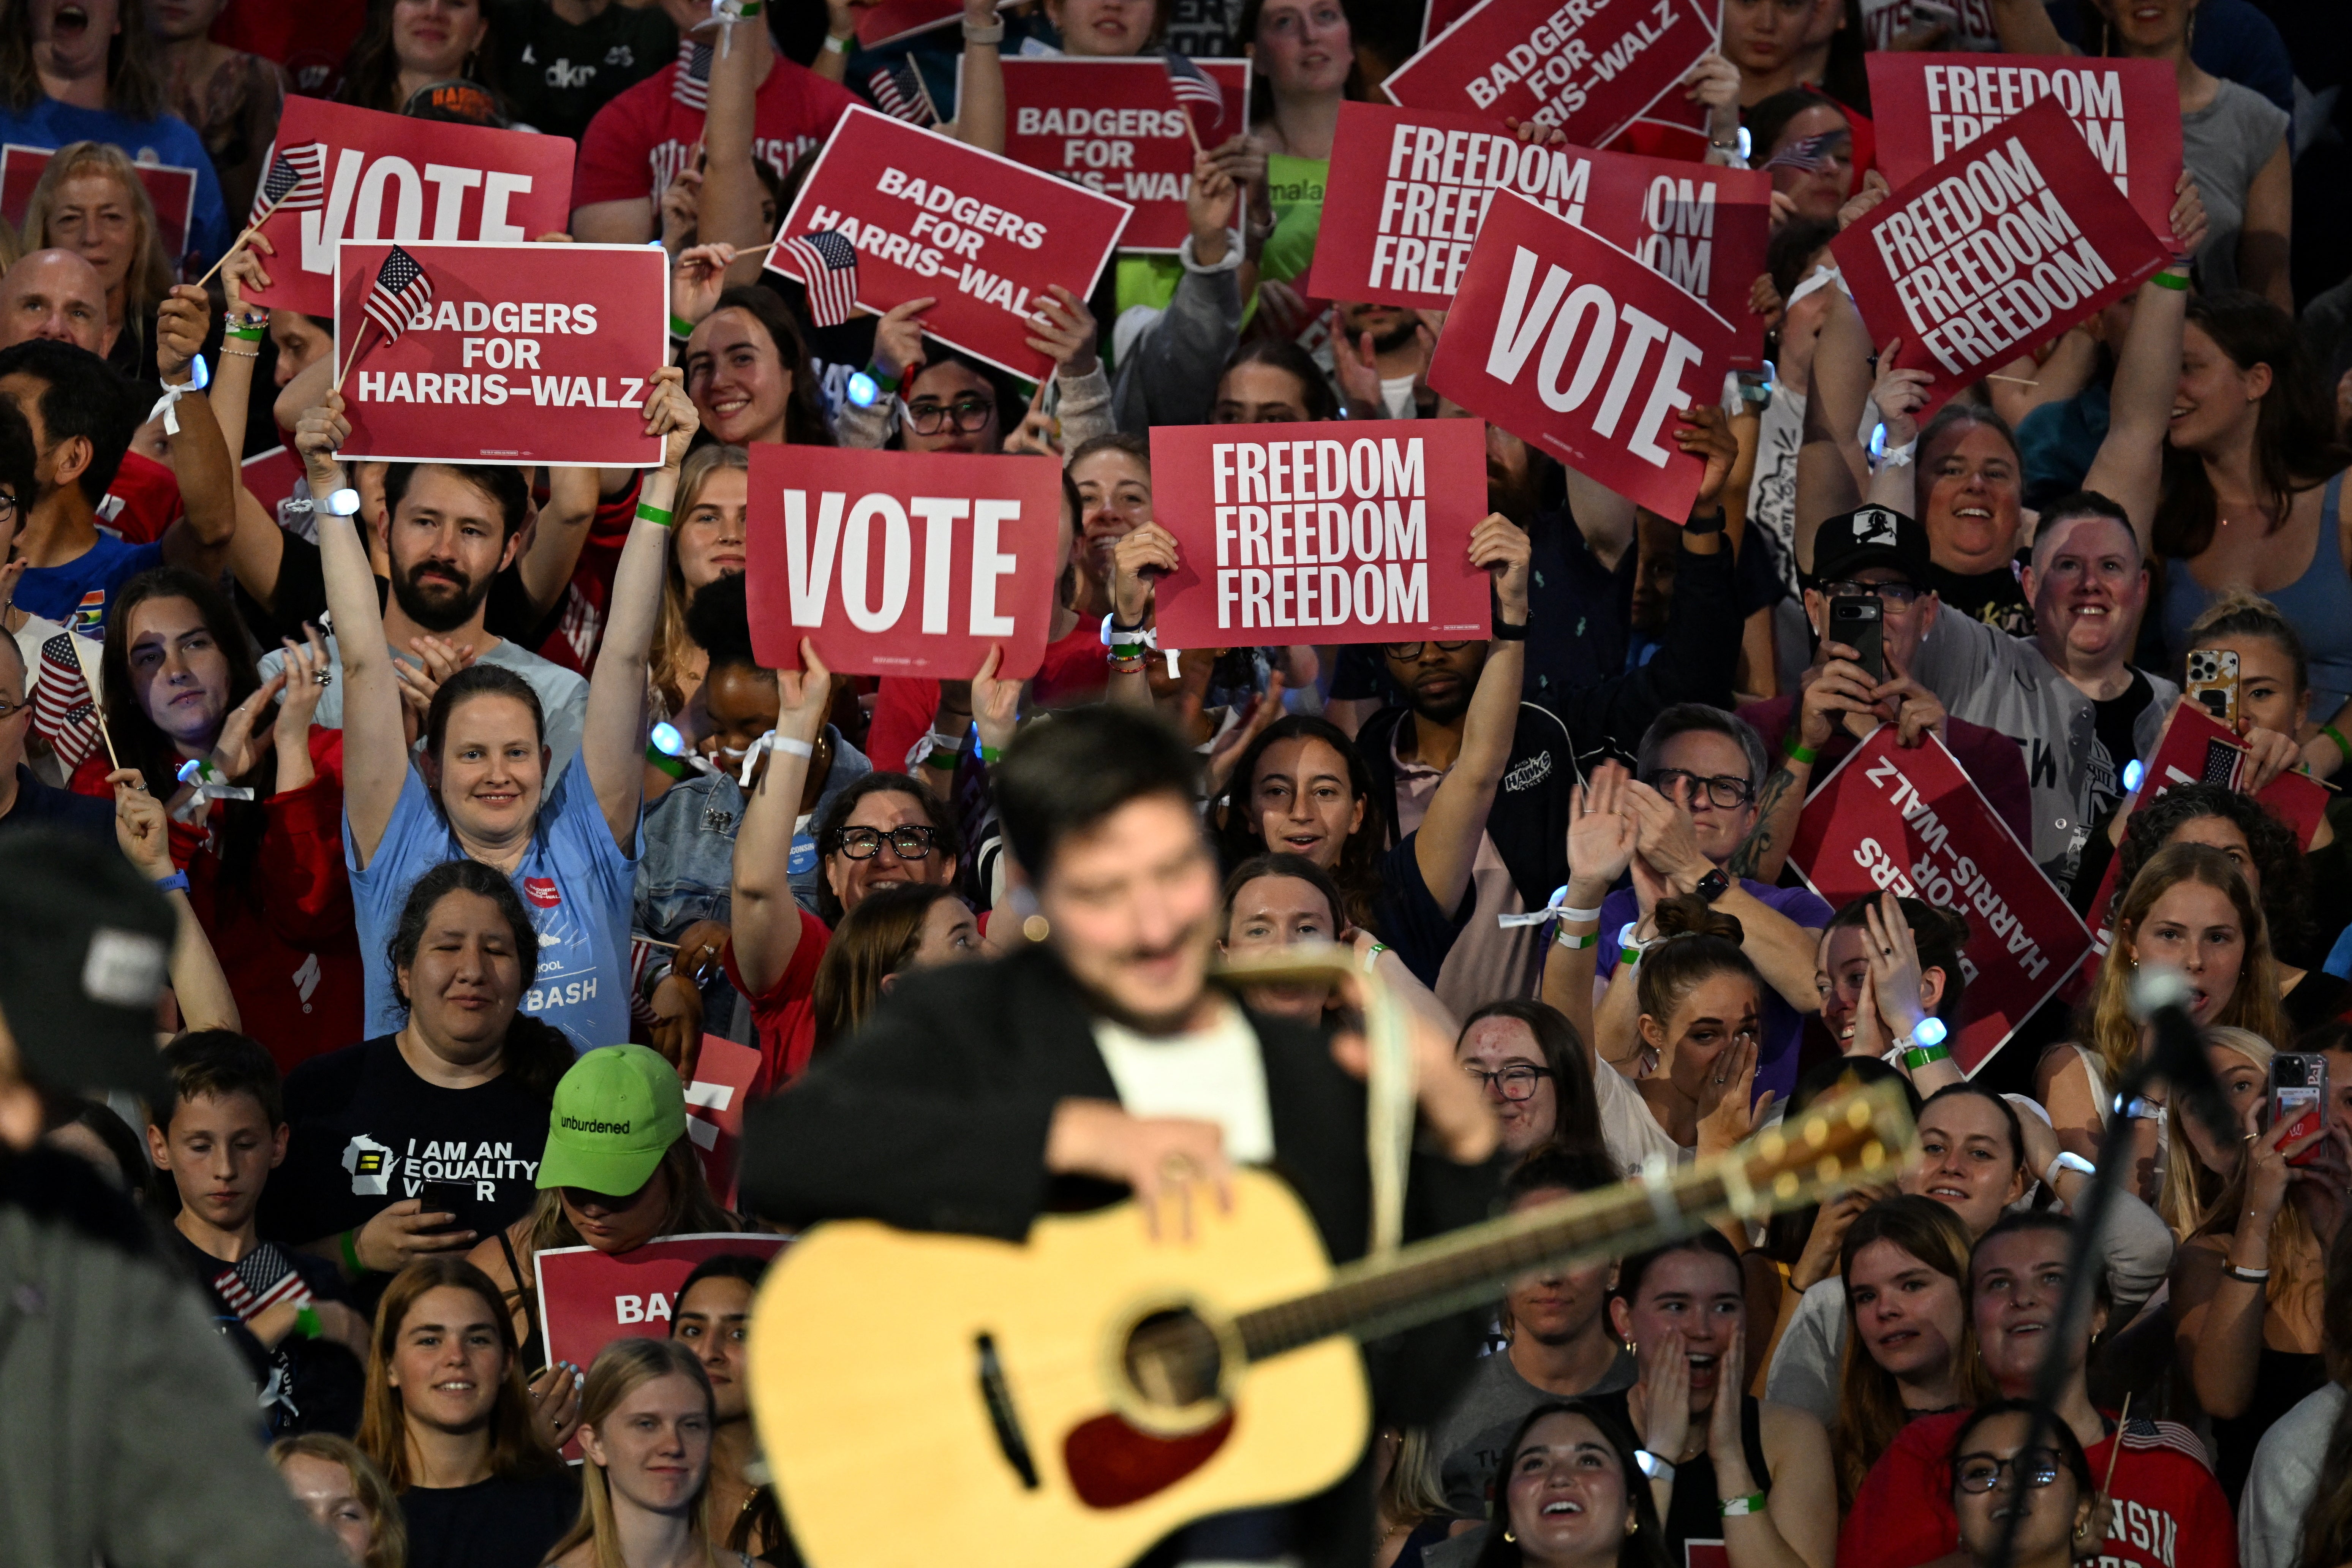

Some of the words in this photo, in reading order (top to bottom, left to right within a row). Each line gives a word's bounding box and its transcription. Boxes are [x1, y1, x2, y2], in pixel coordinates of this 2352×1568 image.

[1525, 39, 1594, 102] FOR
[1532, 3, 1680, 126] RIS-WALZ
[1924, 65, 2124, 120] FREEDOM
[1016, 107, 1186, 138] BADGERS
[1064, 139, 1135, 169] FOR
[1387, 123, 1592, 204] FREEDOM
[301, 142, 532, 275] VOTE
[876, 167, 1048, 249] BADGERS
[910, 212, 985, 260] FOR
[1871, 136, 2047, 281] FREEDOM
[1369, 236, 1472, 296] FREE
[1894, 187, 2082, 335] FREEDOM
[407, 301, 597, 335] BADGERS
[1921, 236, 2117, 375] FREEDOM
[463, 337, 541, 370] FOR
[1485, 244, 1704, 469] VOTE
[358, 371, 643, 409] HARRIS-WALZ
[1212, 438, 1425, 504] FREEDOM
[783, 488, 1021, 637] VOTE
[1215, 499, 1427, 566] FREEDOM
[1217, 563, 1429, 629] FREEDOM
[1505, 750, 1551, 792] HAWKS
[530, 884, 556, 892] BADGERS
[1865, 755, 2050, 981] HARRIS-WALZ
[527, 977, 597, 1012] BASH
[407, 1138, 416, 1156] I
[422, 1141, 466, 1160] AM
[474, 1141, 512, 1159] AN
[561, 1115, 630, 1134] unburdened
[404, 1158, 539, 1181] EQUALITY
